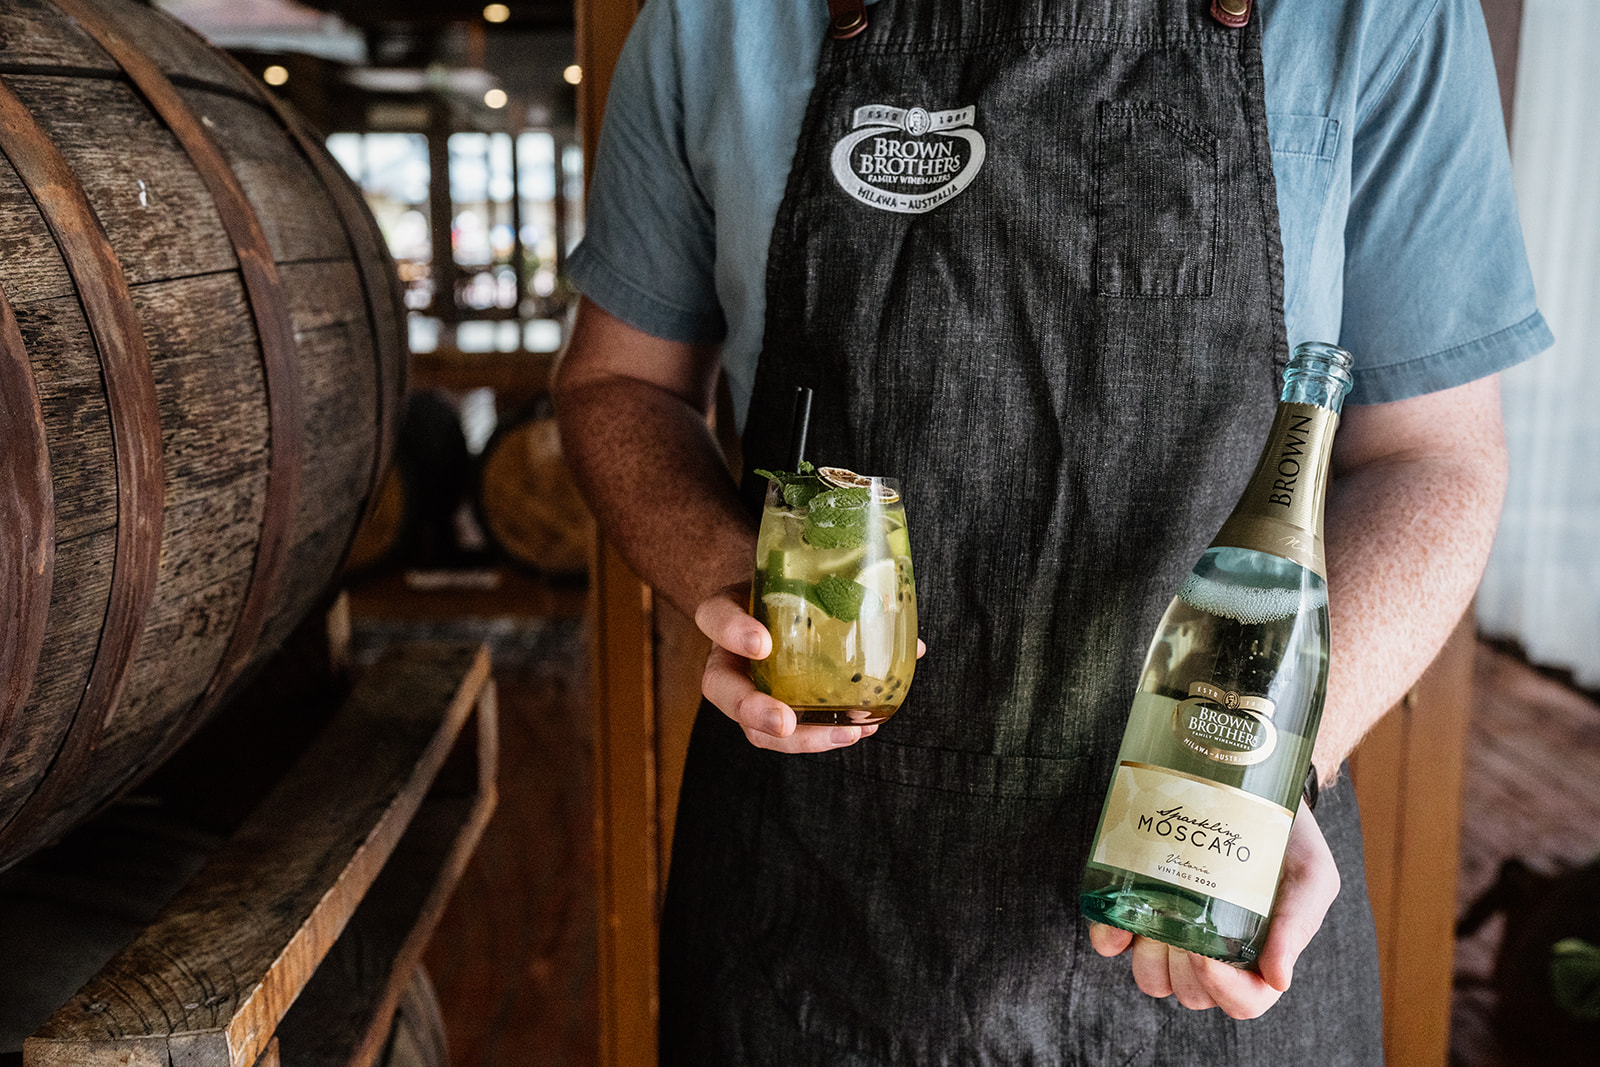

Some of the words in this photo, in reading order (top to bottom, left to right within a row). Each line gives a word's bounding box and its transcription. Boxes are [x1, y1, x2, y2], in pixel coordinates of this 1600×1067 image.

[874, 138, 953, 158] BROWN
[859, 154, 961, 176] BROTHERS
[867, 174, 899, 183] FAMILY
[900, 174, 951, 185] WINEMAKERS
[858, 187, 897, 208] MILAWA
[908, 184, 958, 210] AUSTRALIA
[1268, 415, 1313, 509] BROWN
[1198, 706, 1255, 733] BROWN
[1188, 717, 1258, 747] BROTHERS
[1192, 731, 1212, 739] FAMILY
[1214, 736, 1250, 750] WINEMAKERS
[1183, 737, 1209, 756] MILAWA
[1156, 805, 1243, 846] Sparkling
[1137, 814, 1251, 863] MOSCATO
[1165, 852, 1211, 875] Victoria
[1157, 865, 1192, 882] VINTAGE
[1194, 876, 1218, 889] 2020
